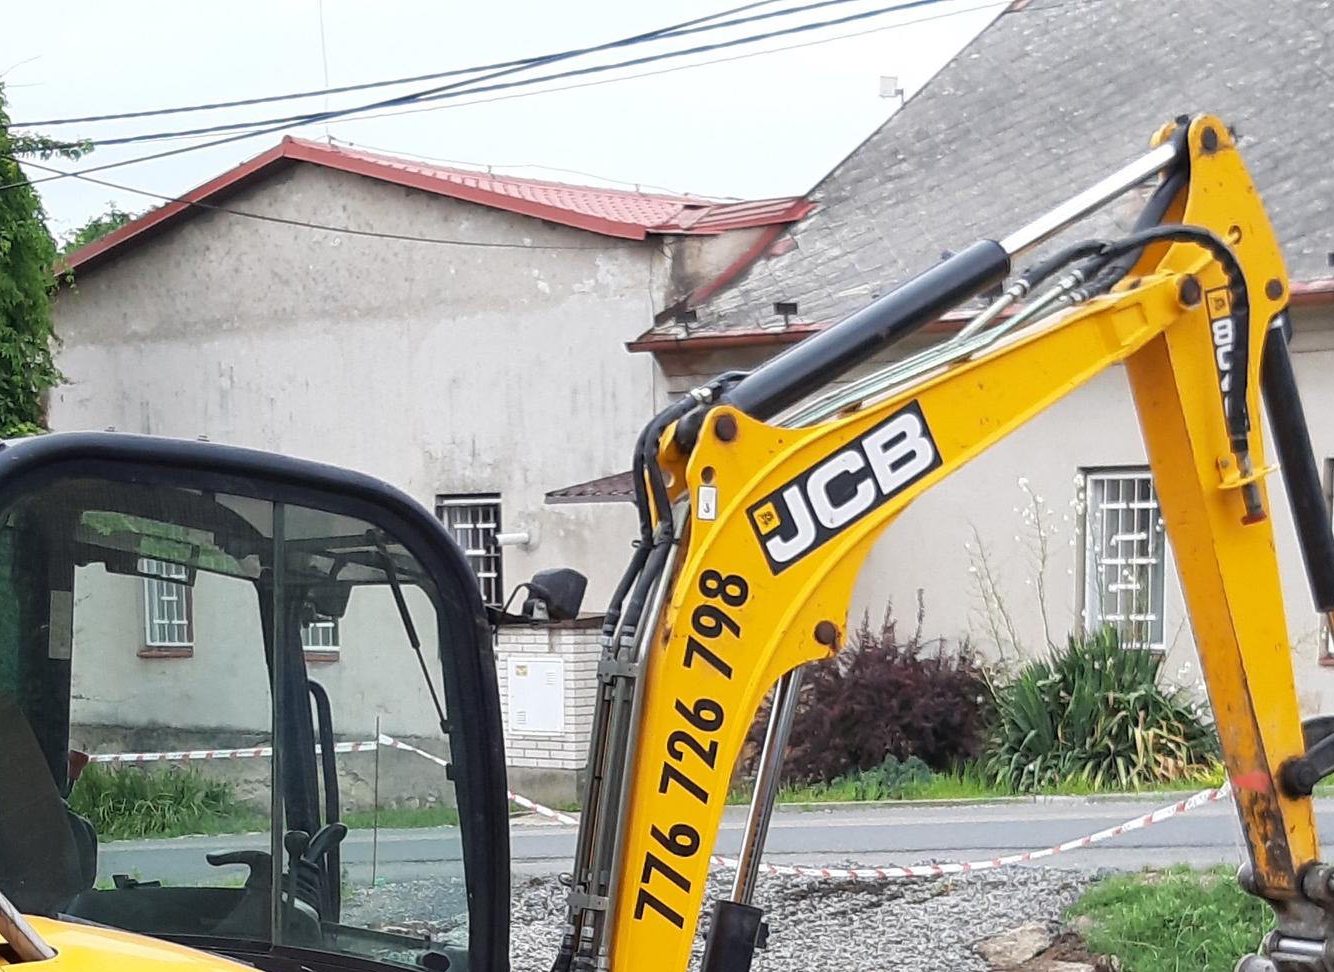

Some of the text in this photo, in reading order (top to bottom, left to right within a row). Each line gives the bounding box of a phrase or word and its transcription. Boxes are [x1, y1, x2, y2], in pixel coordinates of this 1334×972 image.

[766, 413, 934, 563] JCB
[634, 569, 748, 929] 776 726 798
